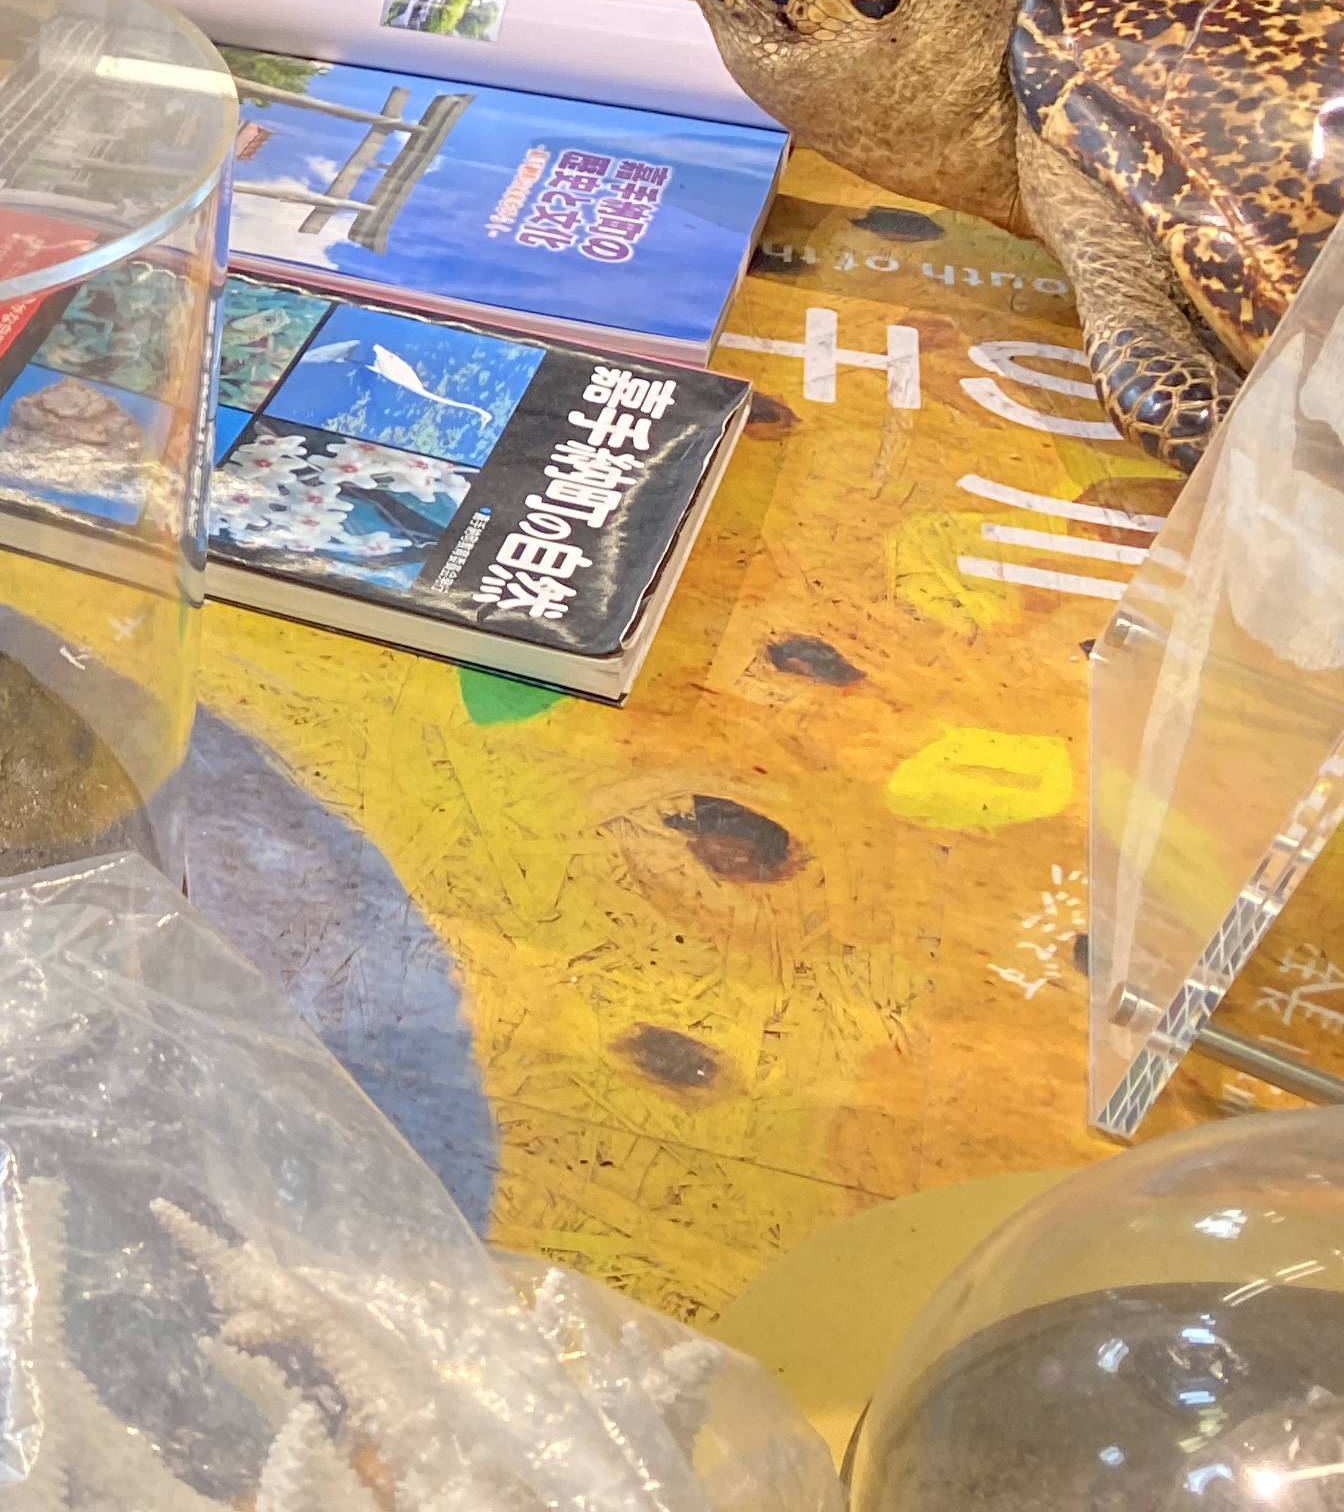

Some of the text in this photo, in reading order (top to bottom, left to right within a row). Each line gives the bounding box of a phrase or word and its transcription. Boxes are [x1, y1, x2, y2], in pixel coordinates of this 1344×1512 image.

[515, 149, 614, 251] 歴史と文化
[762, 241, 821, 265] th
[921, 262, 1070, 296] outh
[472, 364, 678, 620] 嘉手納町の自然
